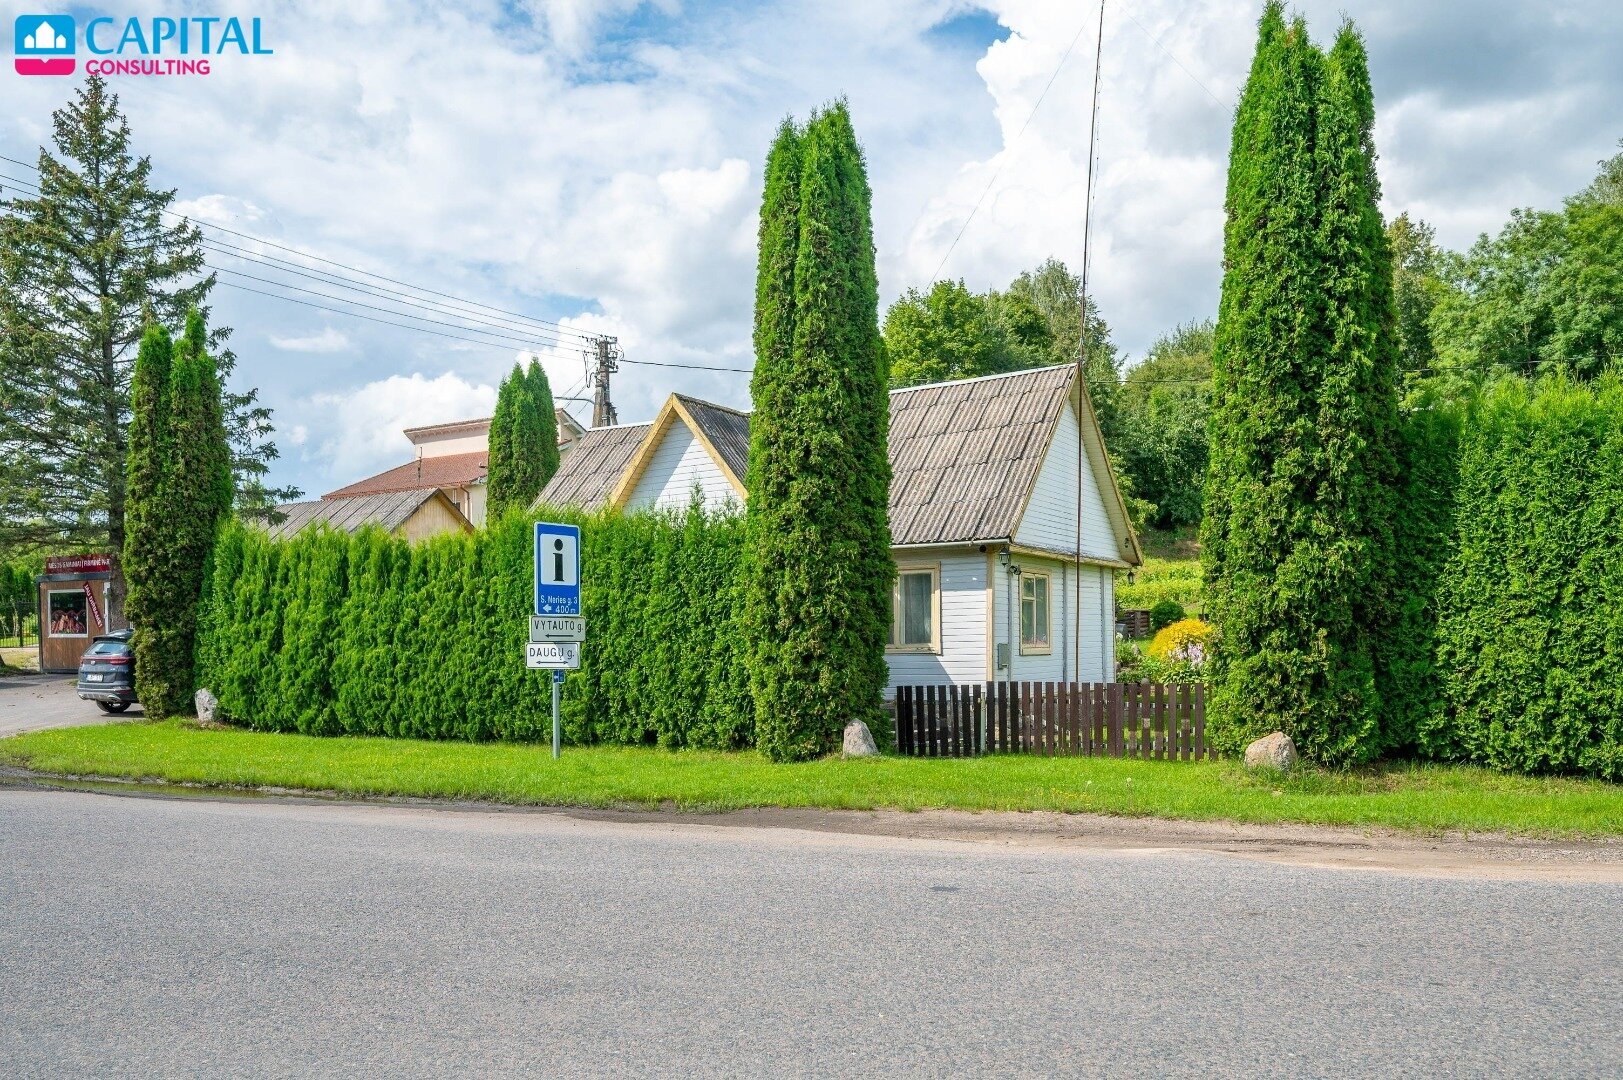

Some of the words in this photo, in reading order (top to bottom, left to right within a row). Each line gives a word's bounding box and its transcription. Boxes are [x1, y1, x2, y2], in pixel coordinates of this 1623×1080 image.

[540, 594, 547, 604] S.
[547, 595, 567, 604] Neries
[573, 596, 578, 605] 3
[555, 604, 570, 614] 400
[534, 620, 575, 631] VYTAUTO
[577, 623, 584, 633] g.
[529, 647, 564, 661] DAUGŲ
[566, 649, 575, 660] g.
